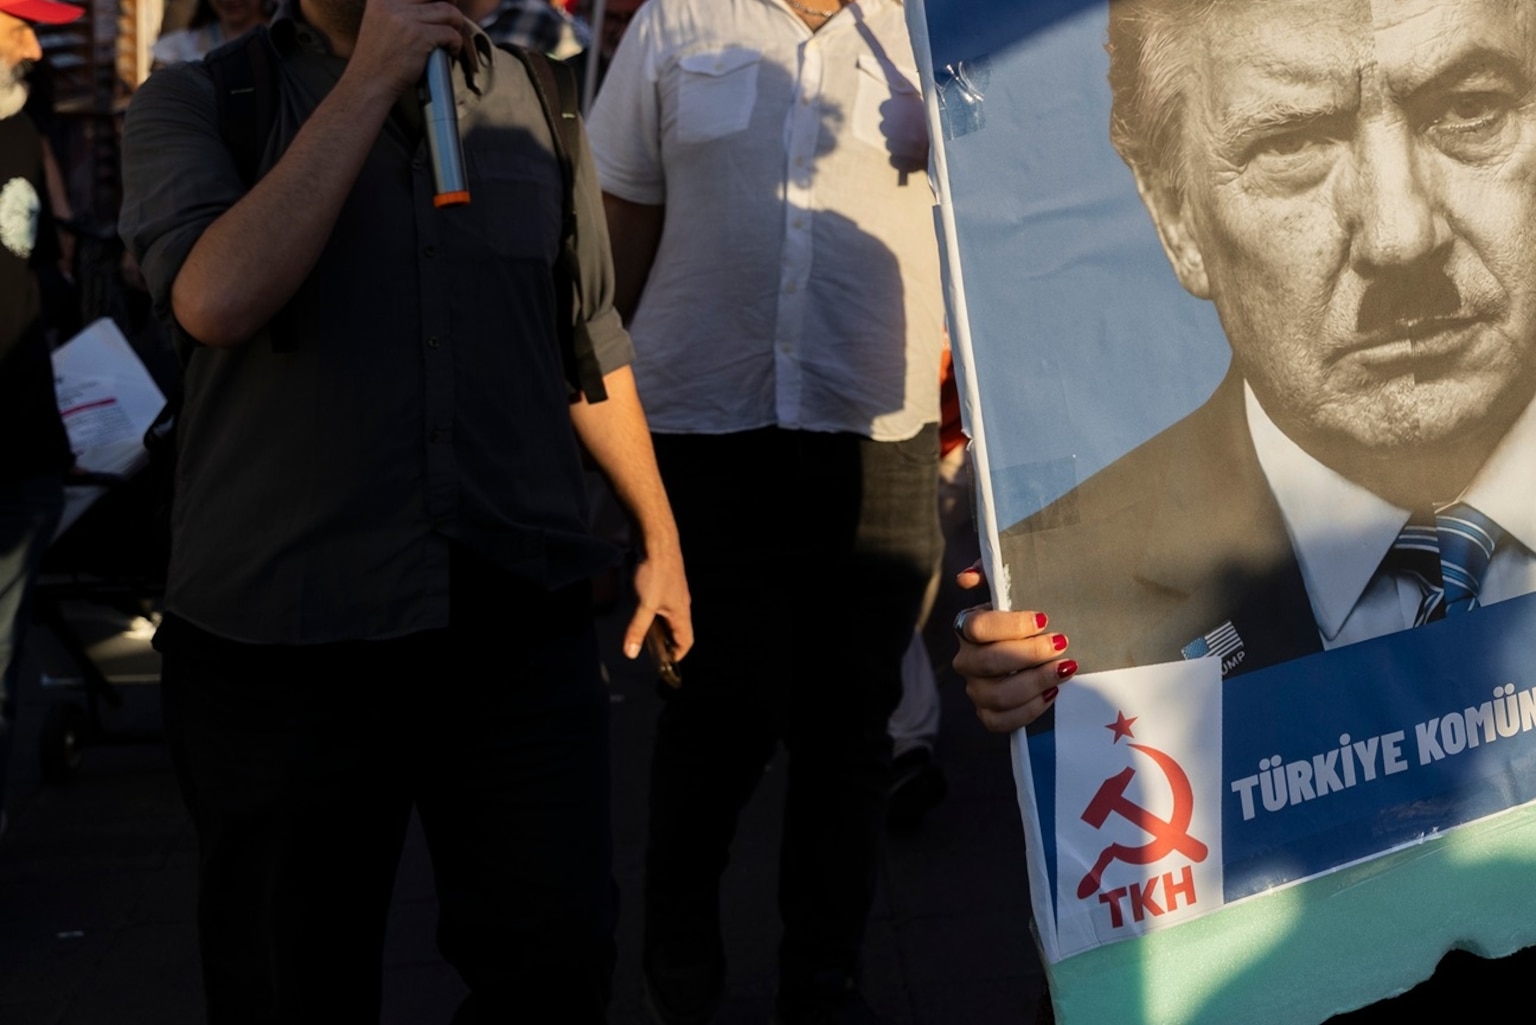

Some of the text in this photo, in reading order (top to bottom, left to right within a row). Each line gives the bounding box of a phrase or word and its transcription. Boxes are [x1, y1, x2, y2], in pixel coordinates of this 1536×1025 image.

[1221, 650, 1247, 676] UMP
[1230, 731, 1408, 822] TÜRKİYE
[1097, 865, 1197, 930] TKH
